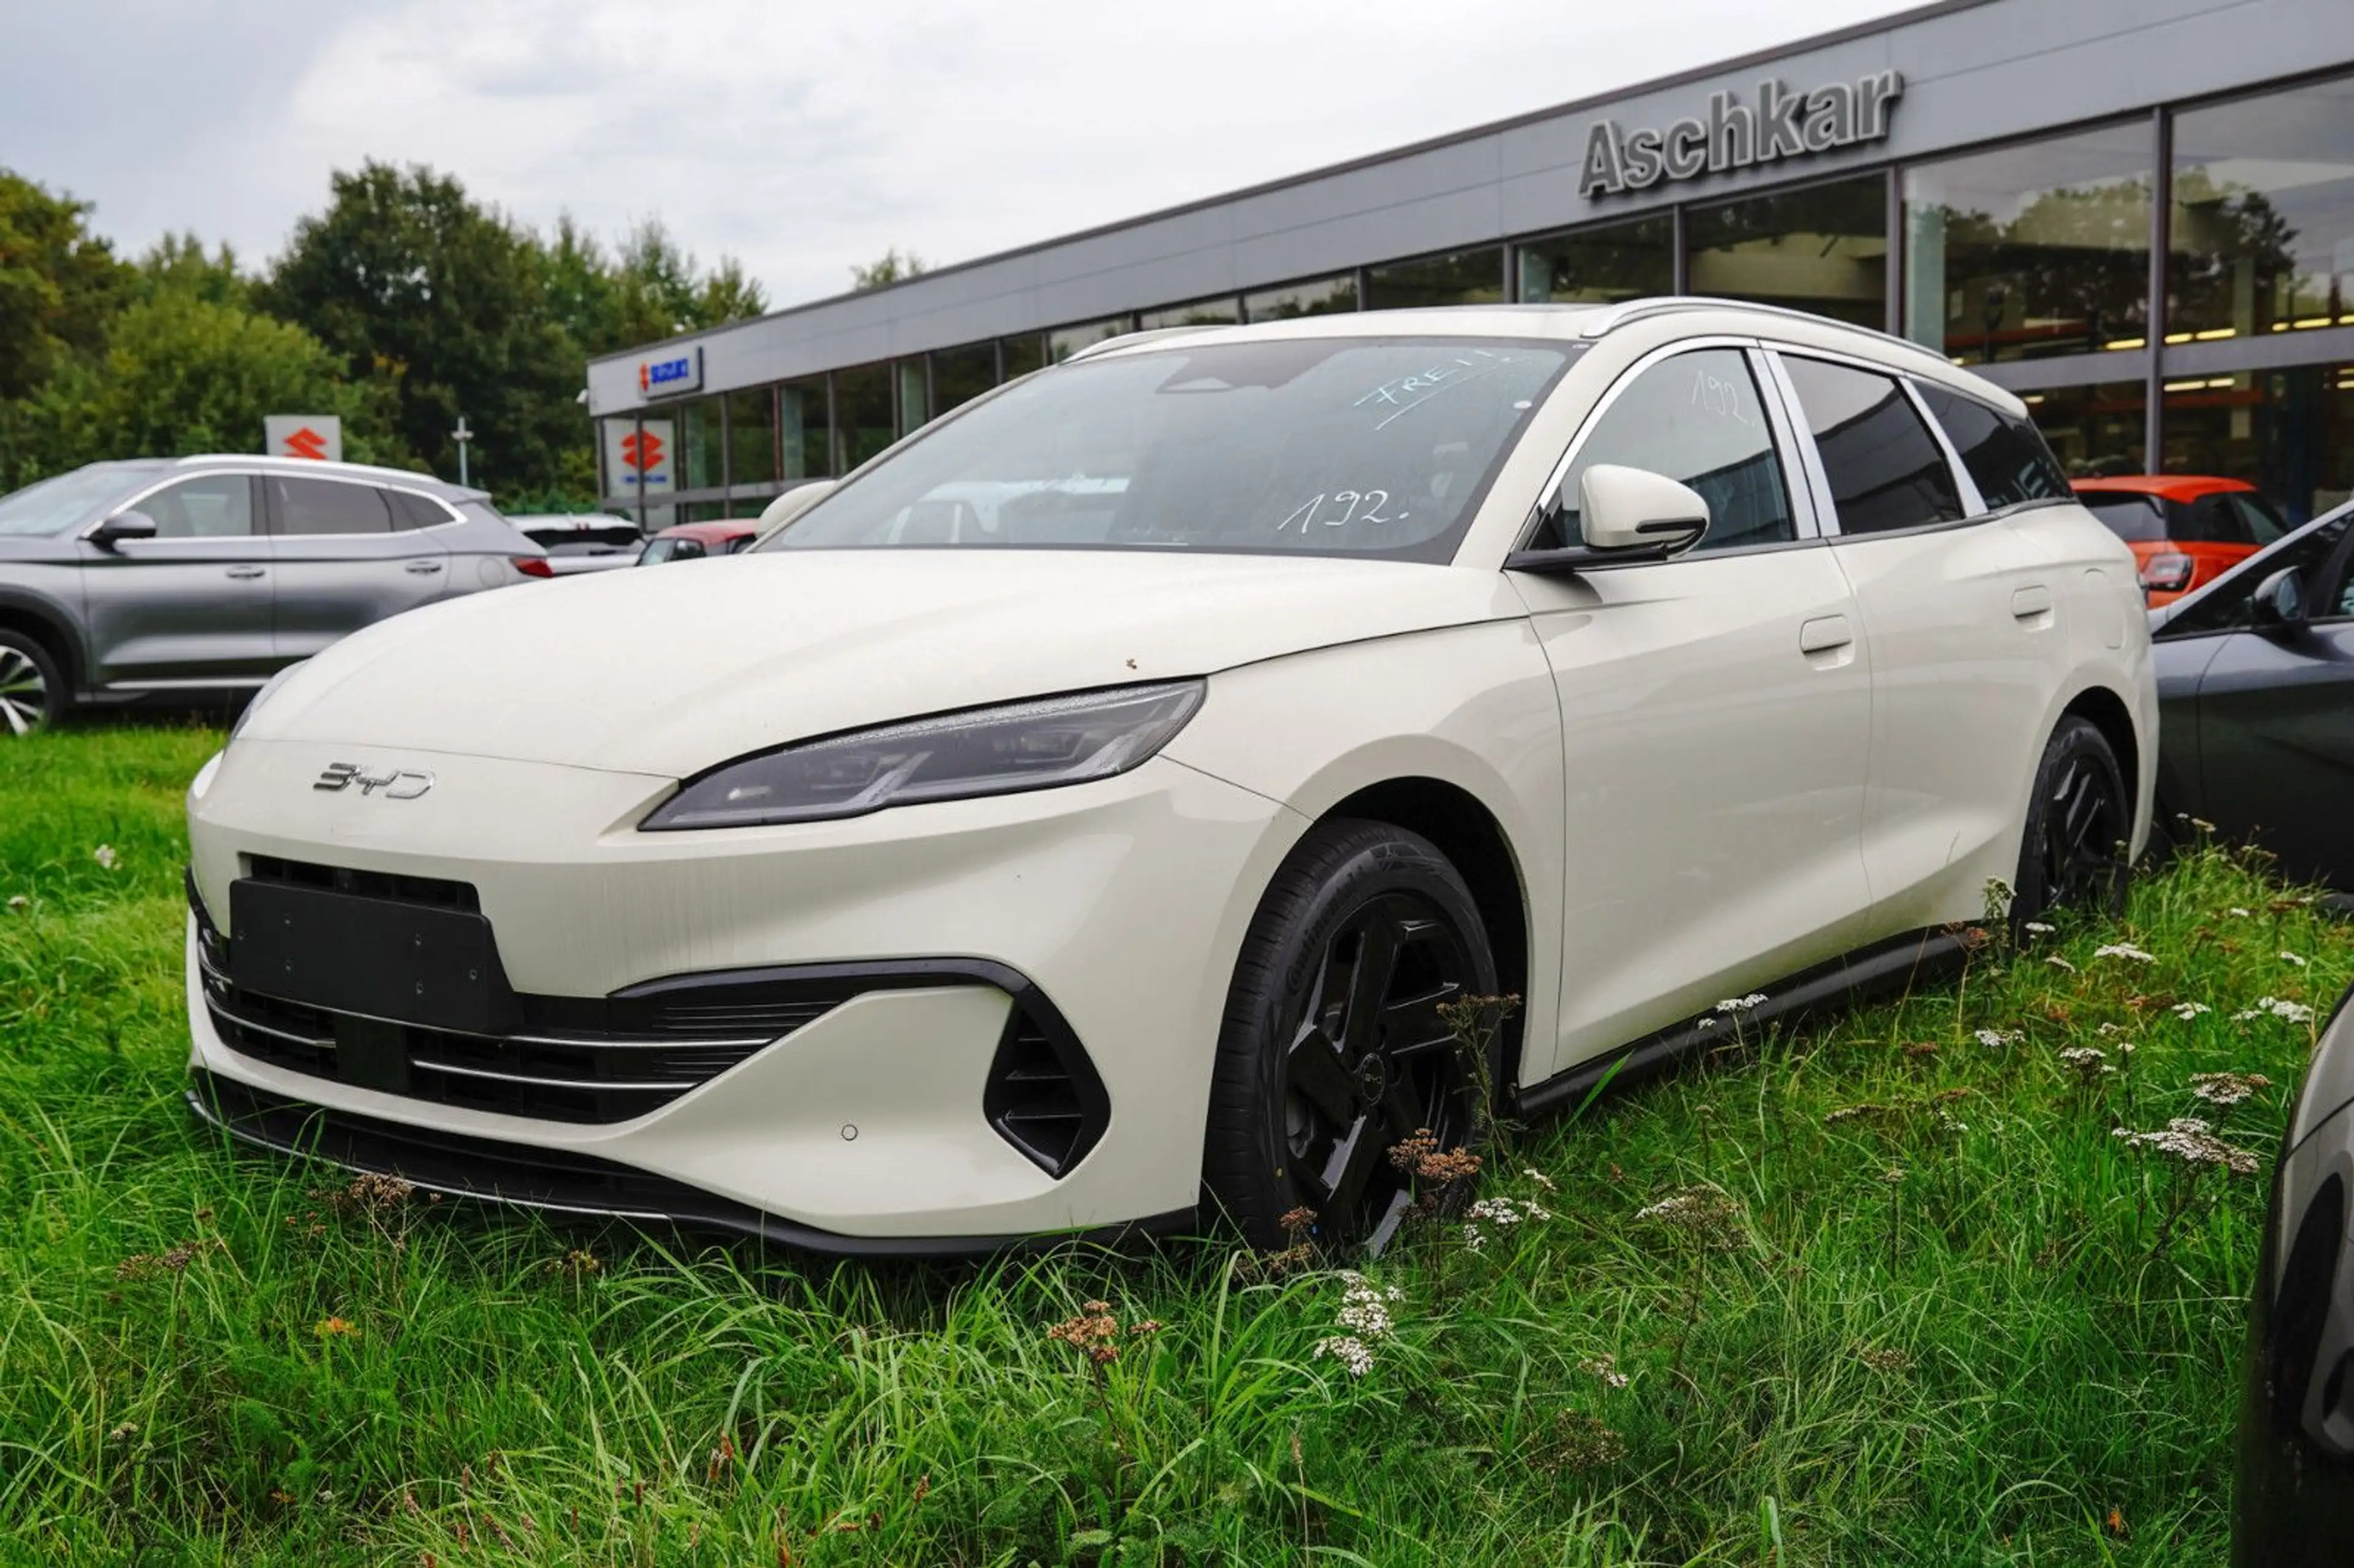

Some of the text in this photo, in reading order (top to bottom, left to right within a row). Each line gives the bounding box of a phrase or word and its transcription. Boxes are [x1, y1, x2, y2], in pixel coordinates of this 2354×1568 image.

[1579, 69, 1905, 199] Aschkar
[1277, 490, 1410, 534] 192.
[313, 762, 436, 799] BYD
